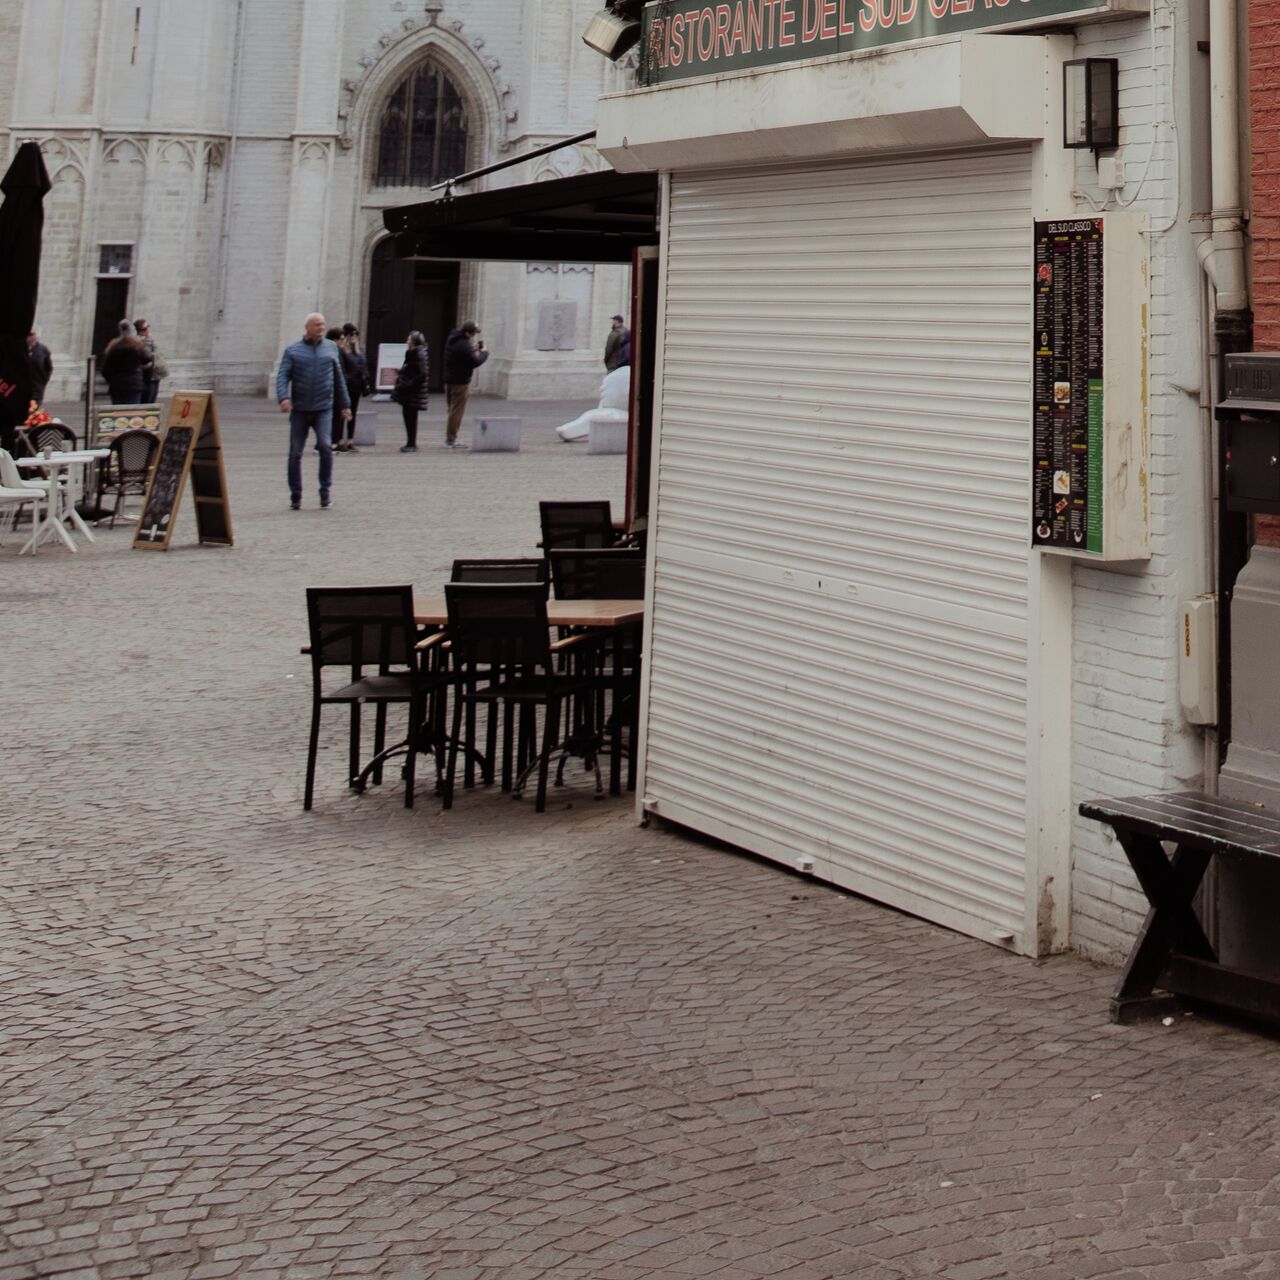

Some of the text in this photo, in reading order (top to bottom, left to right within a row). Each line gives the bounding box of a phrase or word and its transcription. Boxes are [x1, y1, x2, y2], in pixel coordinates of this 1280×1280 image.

[1048, 221, 1091, 233] DEL SUD CLASSICO
